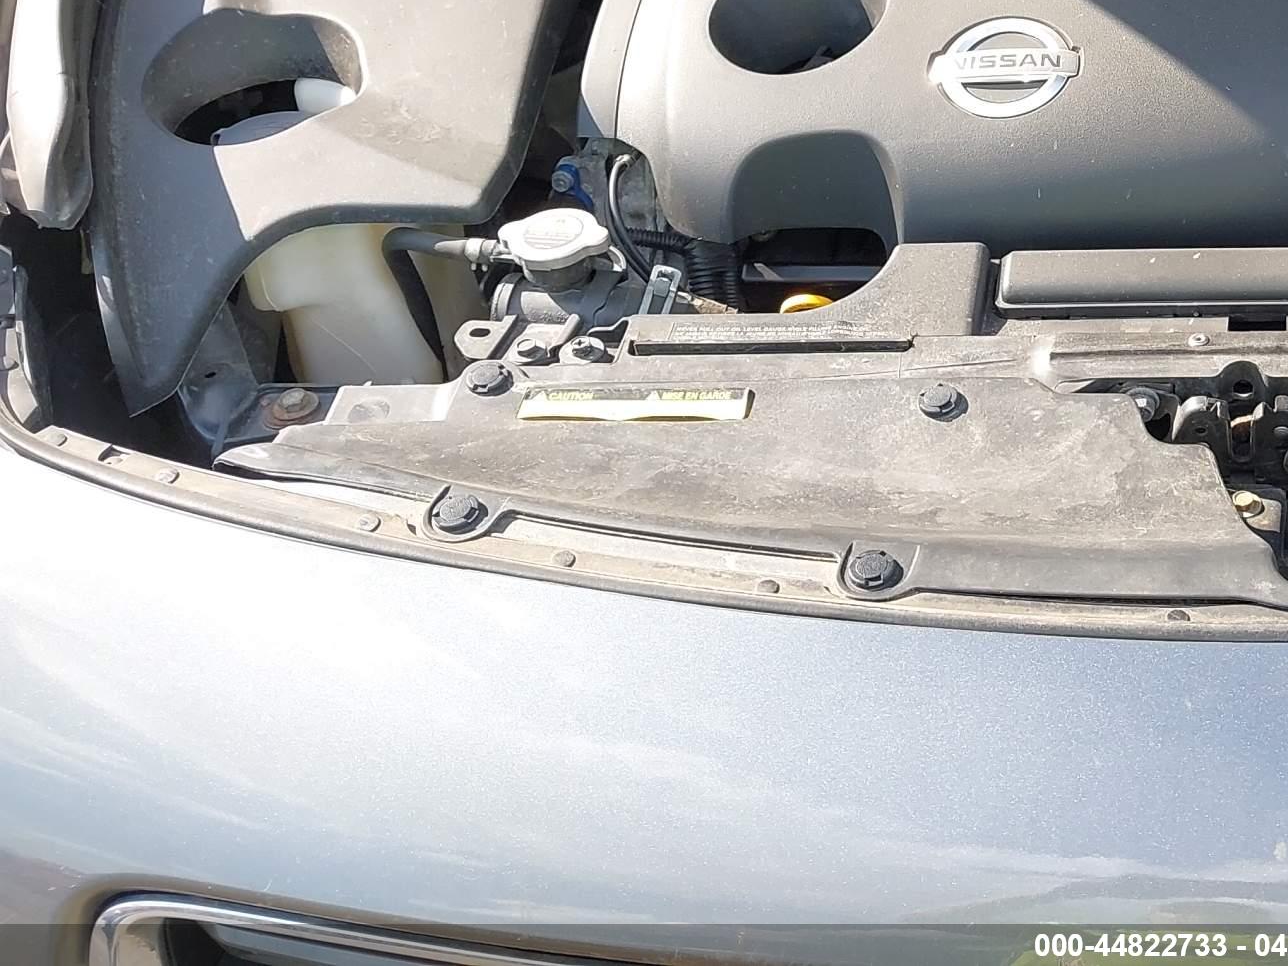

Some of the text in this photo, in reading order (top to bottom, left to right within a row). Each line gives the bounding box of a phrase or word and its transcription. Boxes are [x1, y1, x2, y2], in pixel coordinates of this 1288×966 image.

[955, 53, 1061, 70] NISSAN
[549, 392, 594, 400] CAUTION
[661, 391, 732, 400] MISE EN GARDE
